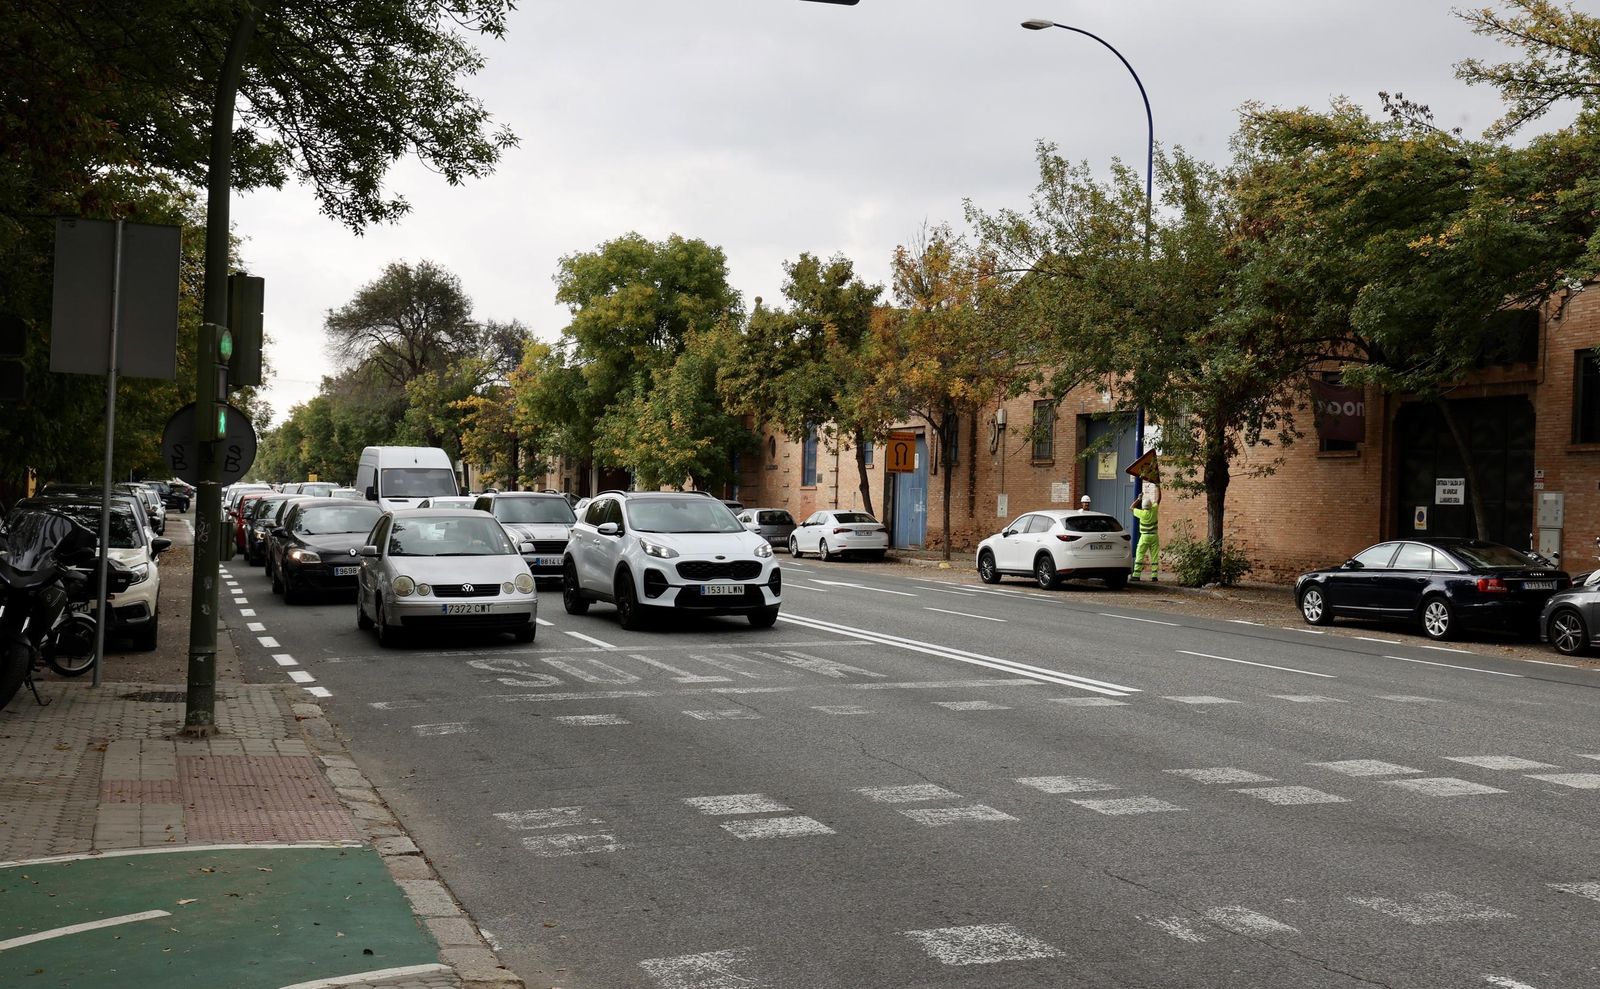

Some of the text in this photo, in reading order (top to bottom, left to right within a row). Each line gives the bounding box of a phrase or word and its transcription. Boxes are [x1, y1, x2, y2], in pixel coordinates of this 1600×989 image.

[340, 567, 357, 575] 9698
[707, 586, 725, 594] 1531
[448, 604, 472, 614] 7372
